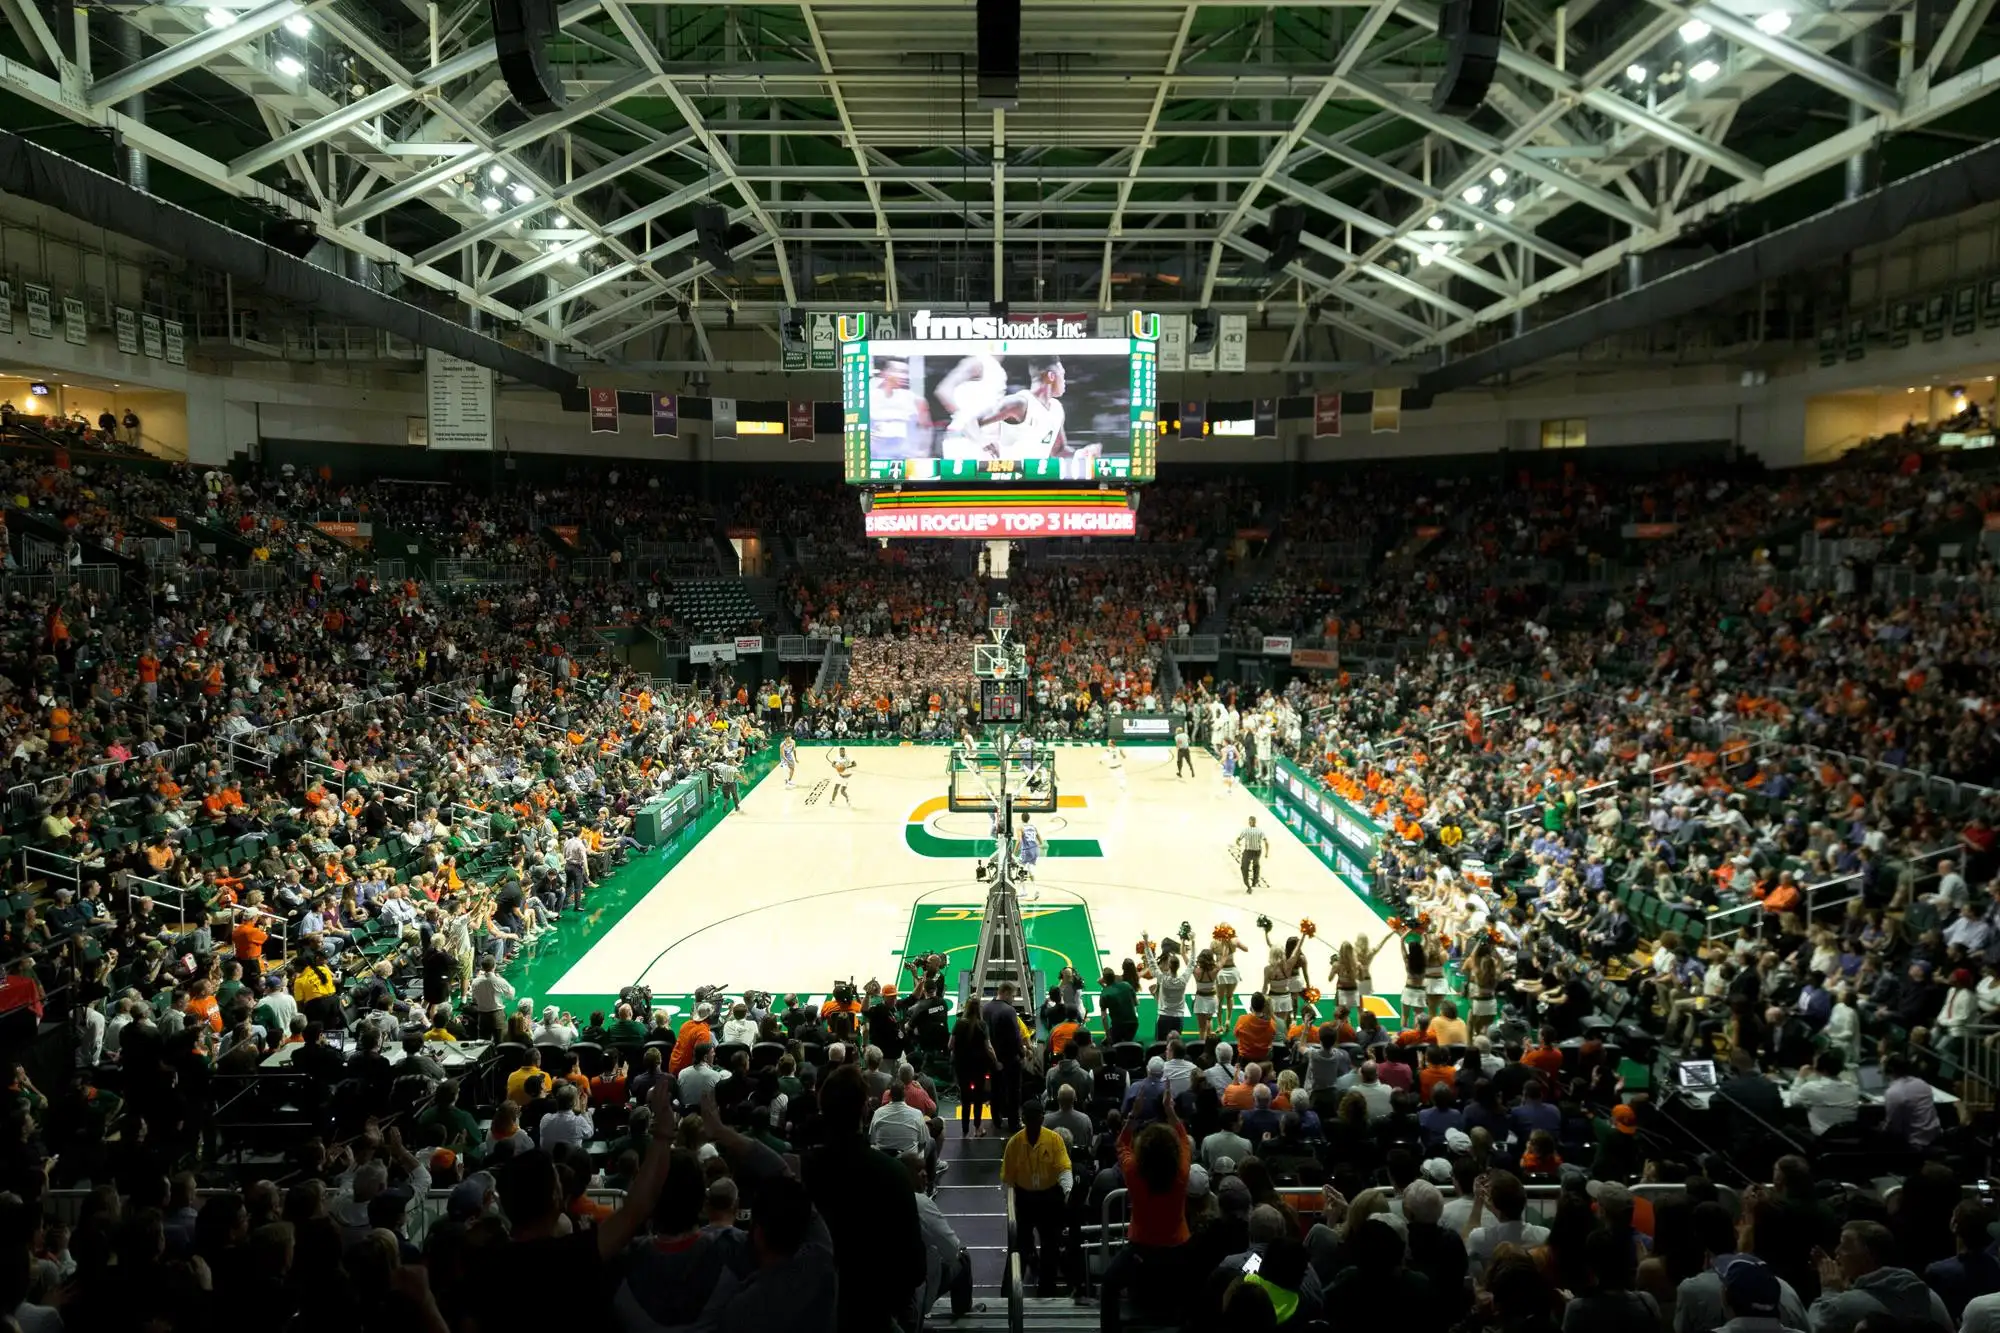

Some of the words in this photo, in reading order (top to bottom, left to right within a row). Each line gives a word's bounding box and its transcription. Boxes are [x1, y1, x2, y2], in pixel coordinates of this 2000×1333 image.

[1056, 318, 1087, 338] Inc.
[814, 331, 833, 342] 24
[1001, 513, 1045, 531] TOP
[1048, 513, 1060, 530] 3
[737, 639, 760, 648] ESPN
